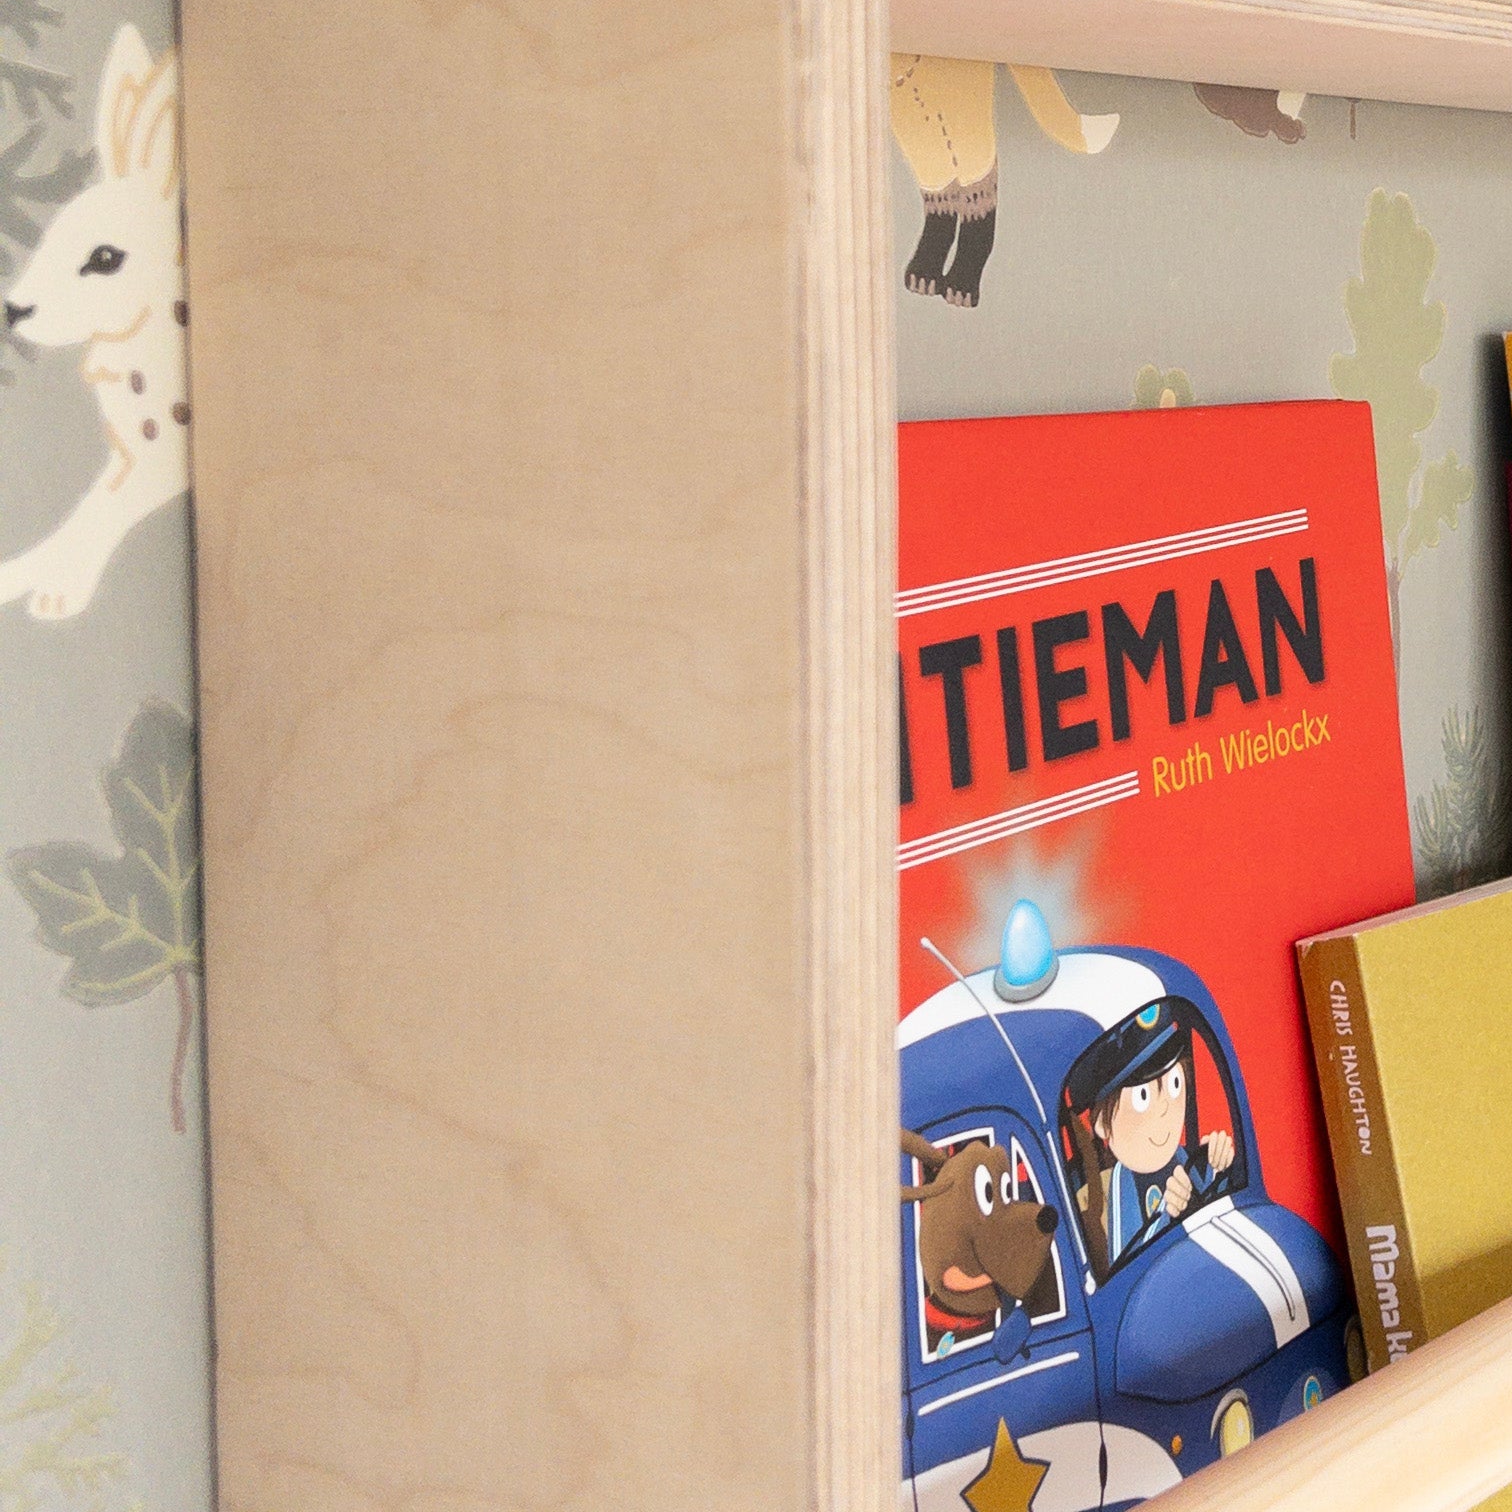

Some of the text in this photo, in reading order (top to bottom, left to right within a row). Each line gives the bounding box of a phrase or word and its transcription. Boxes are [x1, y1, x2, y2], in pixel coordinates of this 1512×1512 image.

[1152, 708, 1332, 798] Ruth Wielockx
[1330, 980, 1373, 1156] CHRIS HAUGHTON
